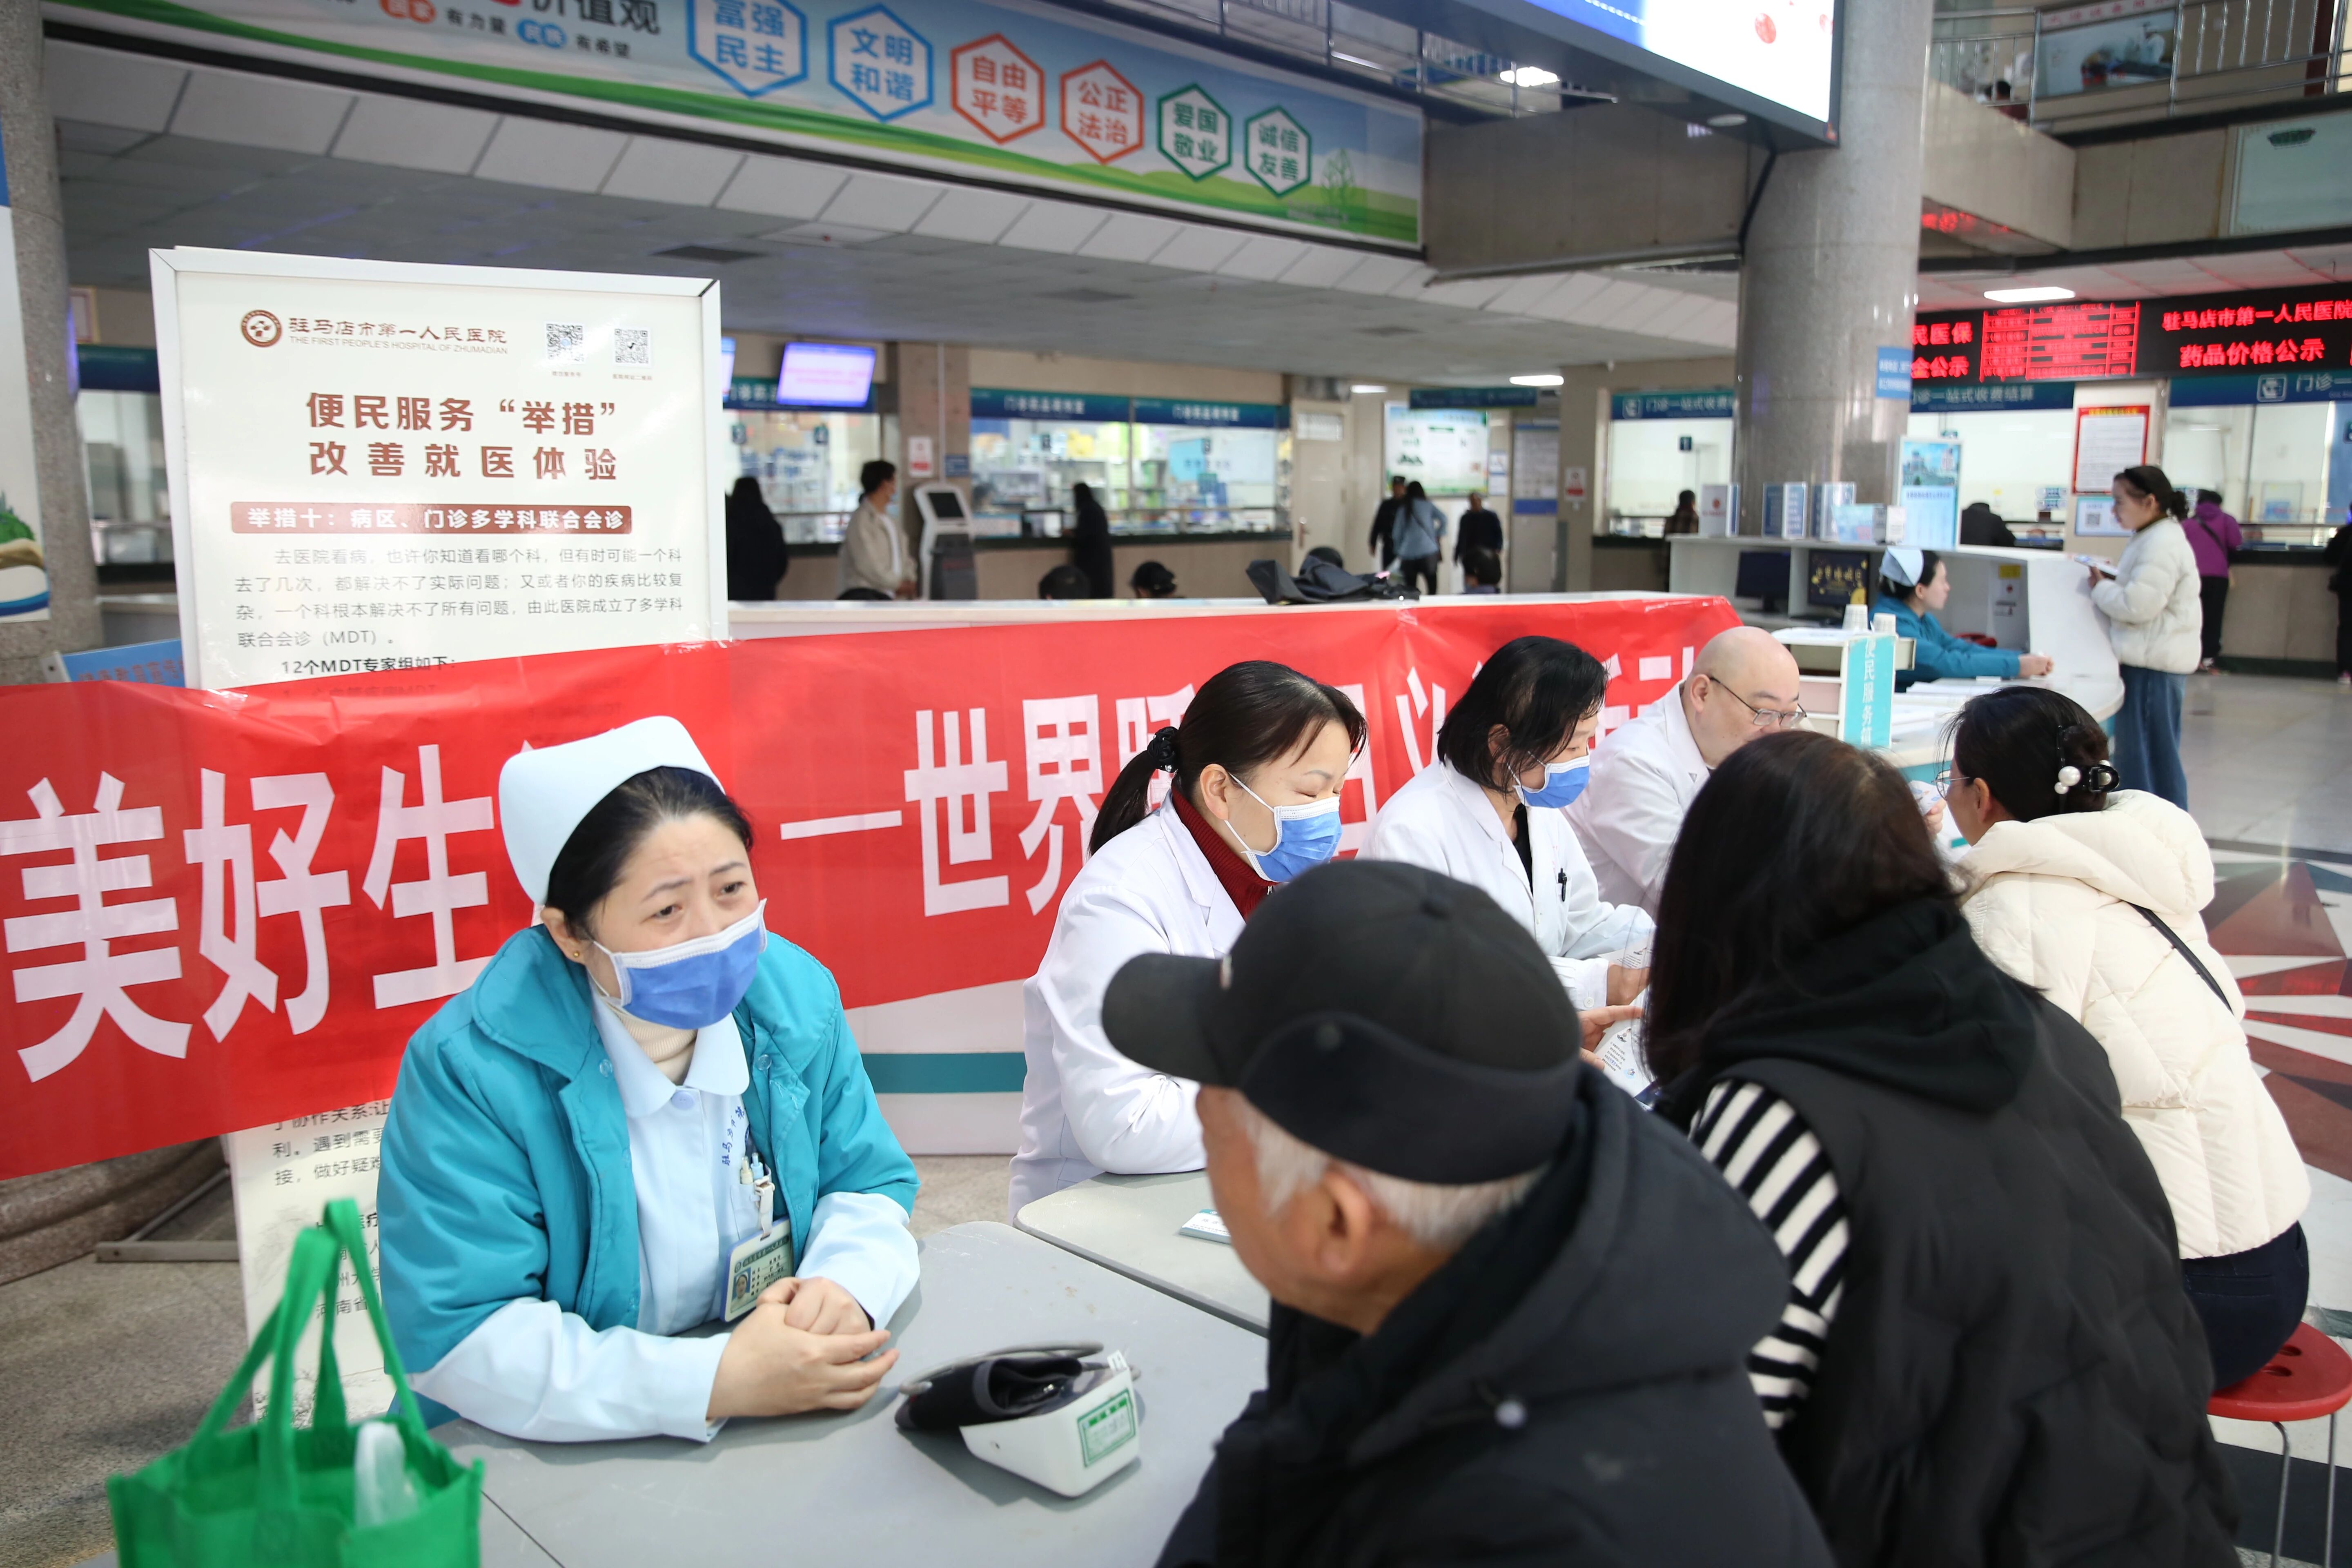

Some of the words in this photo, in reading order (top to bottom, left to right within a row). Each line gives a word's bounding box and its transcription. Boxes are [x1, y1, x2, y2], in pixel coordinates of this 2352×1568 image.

[715, 34, 786, 76] 民主
[851, 27, 913, 66] 文明
[851, 63, 914, 102] 和谐
[972, 56, 1027, 91] 自由
[971, 89, 1027, 125] 平等
[1078, 80, 1128, 114] 公正
[1078, 112, 1128, 145] 法治
[1174, 102, 1218, 134] 爱国
[1174, 131, 1218, 163] 敬业
[1258, 122, 1298, 153] 诚信
[1259, 152, 1298, 181] 友善
[289, 317, 507, 343] 驻马店市第一人民医院
[2162, 299, 2352, 331] 驻马店市第一人民医院
[290, 336, 309, 344] THE
[311, 336, 339, 346] FIRST
[343, 339, 389, 349] PEOPLE'S
[391, 341, 437, 351] HOSPITAL
[439, 343, 452, 352] OF
[454, 344, 508, 354] ZHUMADIAN
[2180, 338, 2325, 368] 药品价格公示
[310, 441, 617, 480] 改善就医体验
[0, 740, 535, 1083] 美好生
